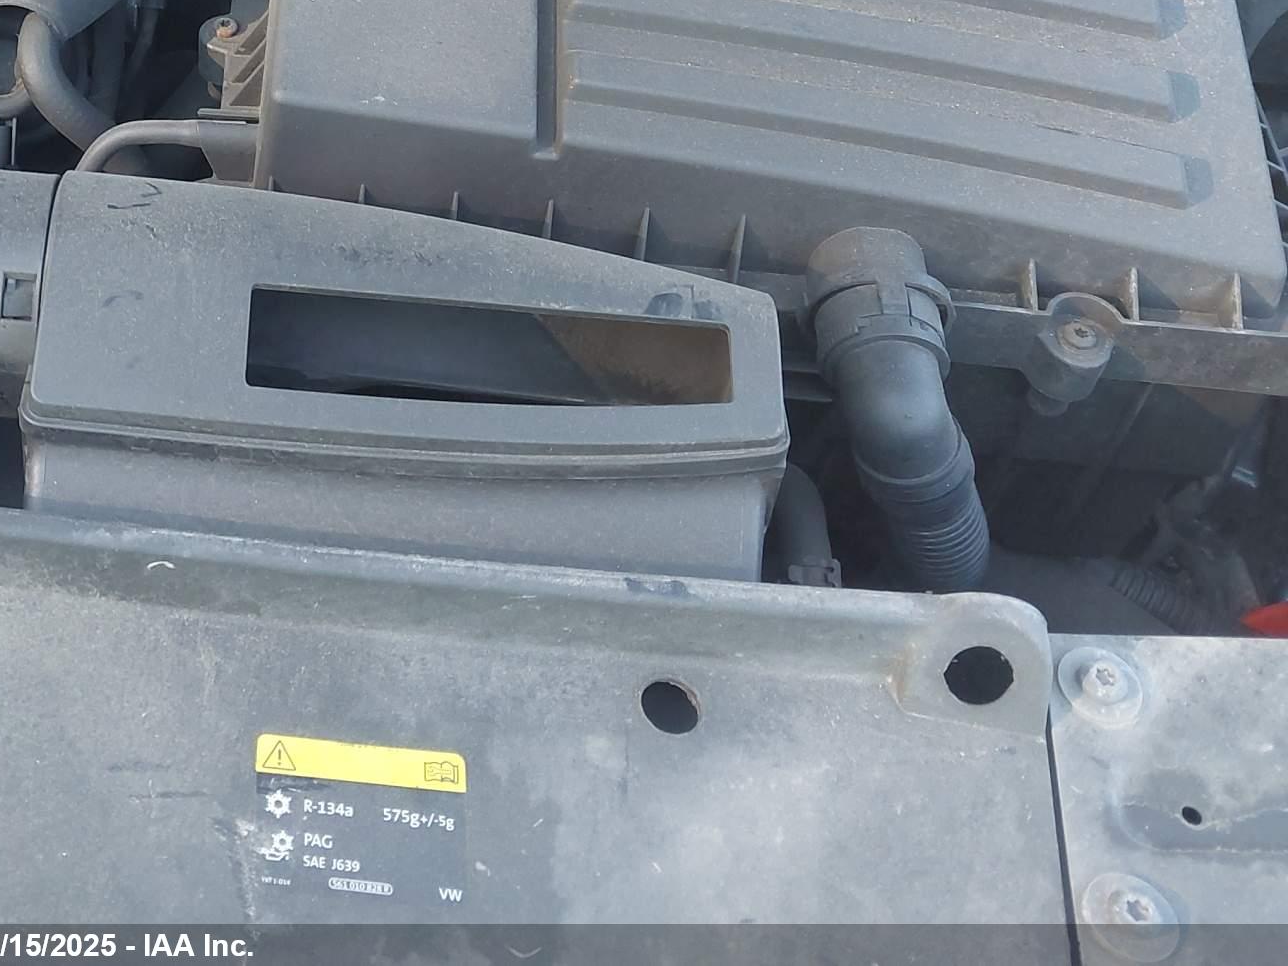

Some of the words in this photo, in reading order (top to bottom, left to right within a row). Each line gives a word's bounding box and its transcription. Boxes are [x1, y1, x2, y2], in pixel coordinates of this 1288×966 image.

[303, 797, 355, 817] R-134a
[383, 807, 456, 832] 575g+/-5g
[303, 832, 334, 849] PAG
[302, 854, 327, 869] SAE
[330, 857, 361, 873] J639
[438, 886, 464, 903] VW
